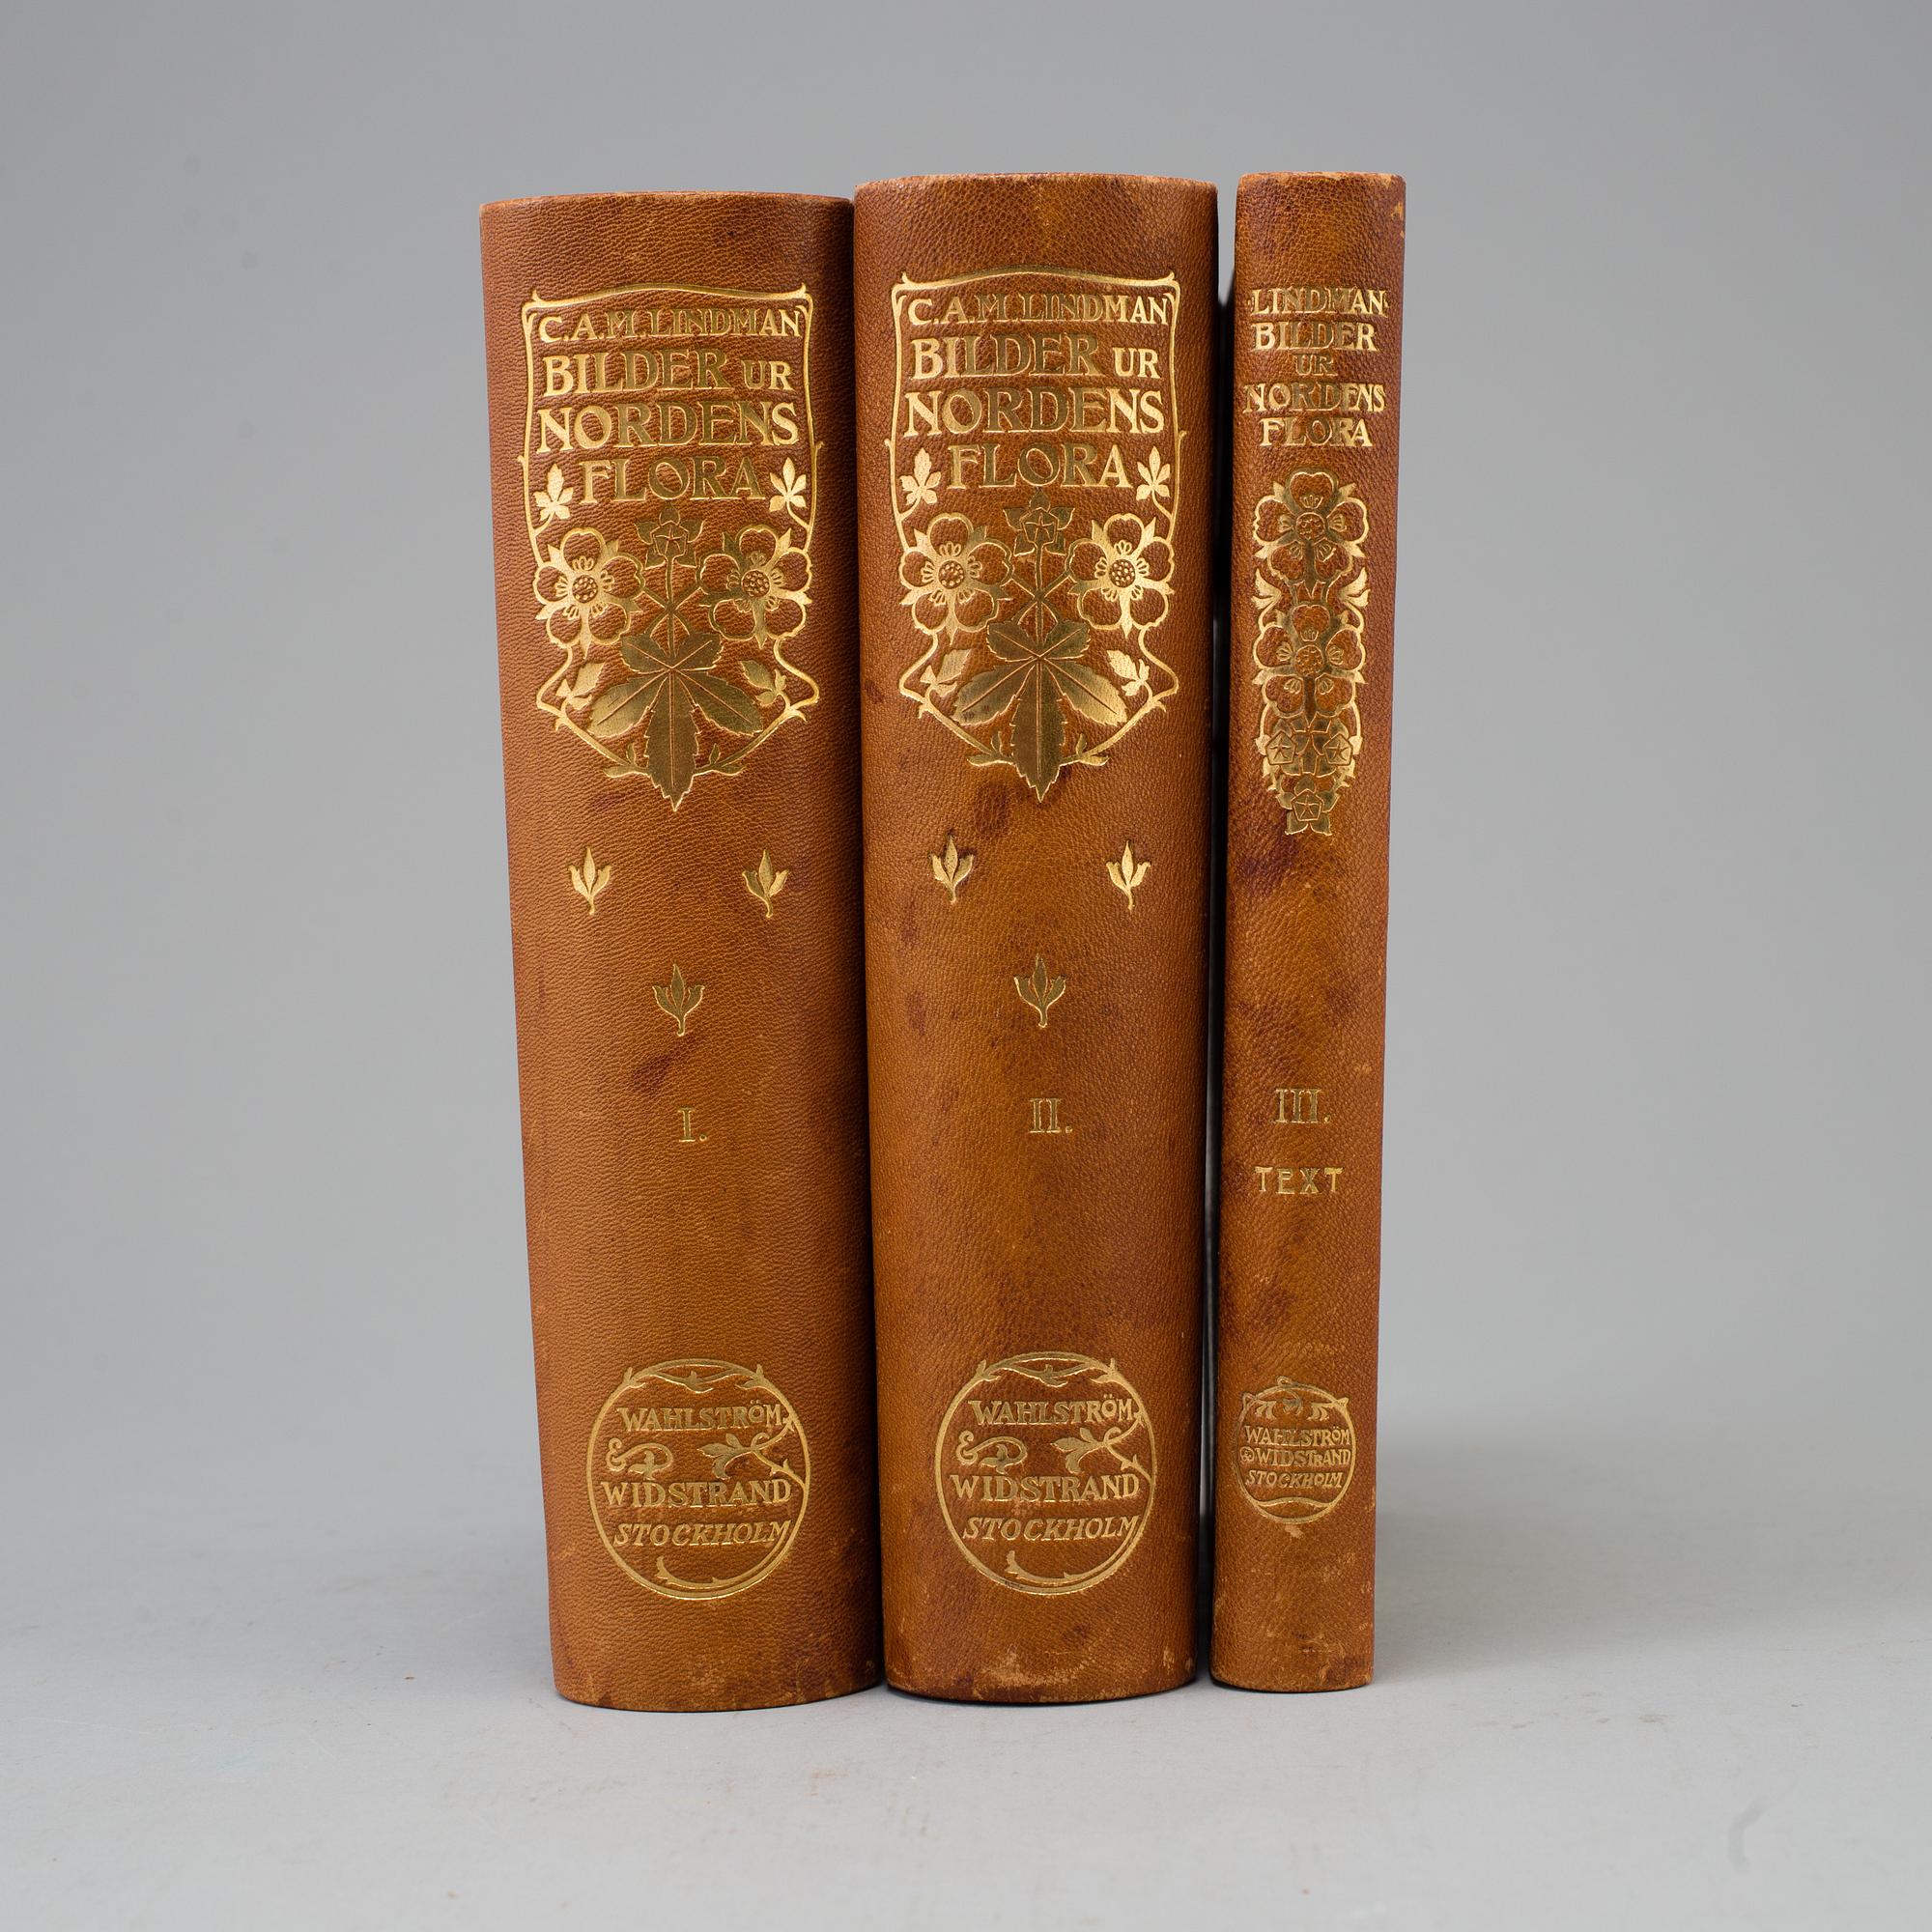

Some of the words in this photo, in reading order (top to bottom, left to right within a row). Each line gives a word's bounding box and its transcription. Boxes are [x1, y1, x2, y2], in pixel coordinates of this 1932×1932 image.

[1251, 287, 1388, 317] LINDMAN
[1251, 321, 1379, 351] BILDER
[910, 332, 1105, 380] BILDER
[1112, 347, 1160, 379] UR
[1293, 353, 1339, 377] UR
[542, 349, 730, 397] BILDER
[743, 359, 795, 391] UR
[903, 387, 1165, 437] NORDENS
[1242, 383, 1386, 413] NORDENS
[536, 401, 799, 453] NORDENS
[1259, 416, 1373, 447] FLORA
[580, 456, 766, 503] FLORA
[948, 443, 1133, 489] FLORA
[1028, 1097, 1073, 1133] II.
[1254, 1166, 1344, 1194] TEXT
[616, 1400, 781, 1431] WAHLSTRÖM
[968, 1394, 1133, 1425] WAHLSTRÖM
[1244, 1426, 1350, 1446] WAHLSTRÖM
[1255, 1448, 1351, 1466] WIDSTRAND
[600, 1479, 792, 1507] WIDSTRAND
[949, 1473, 1141, 1502] WIDSTRAND
[1245, 1469, 1344, 1489] STOCKHOLM
[613, 1520, 792, 1546] STOCKHOLM
[962, 1515, 1140, 1541] STOCKHOLM
